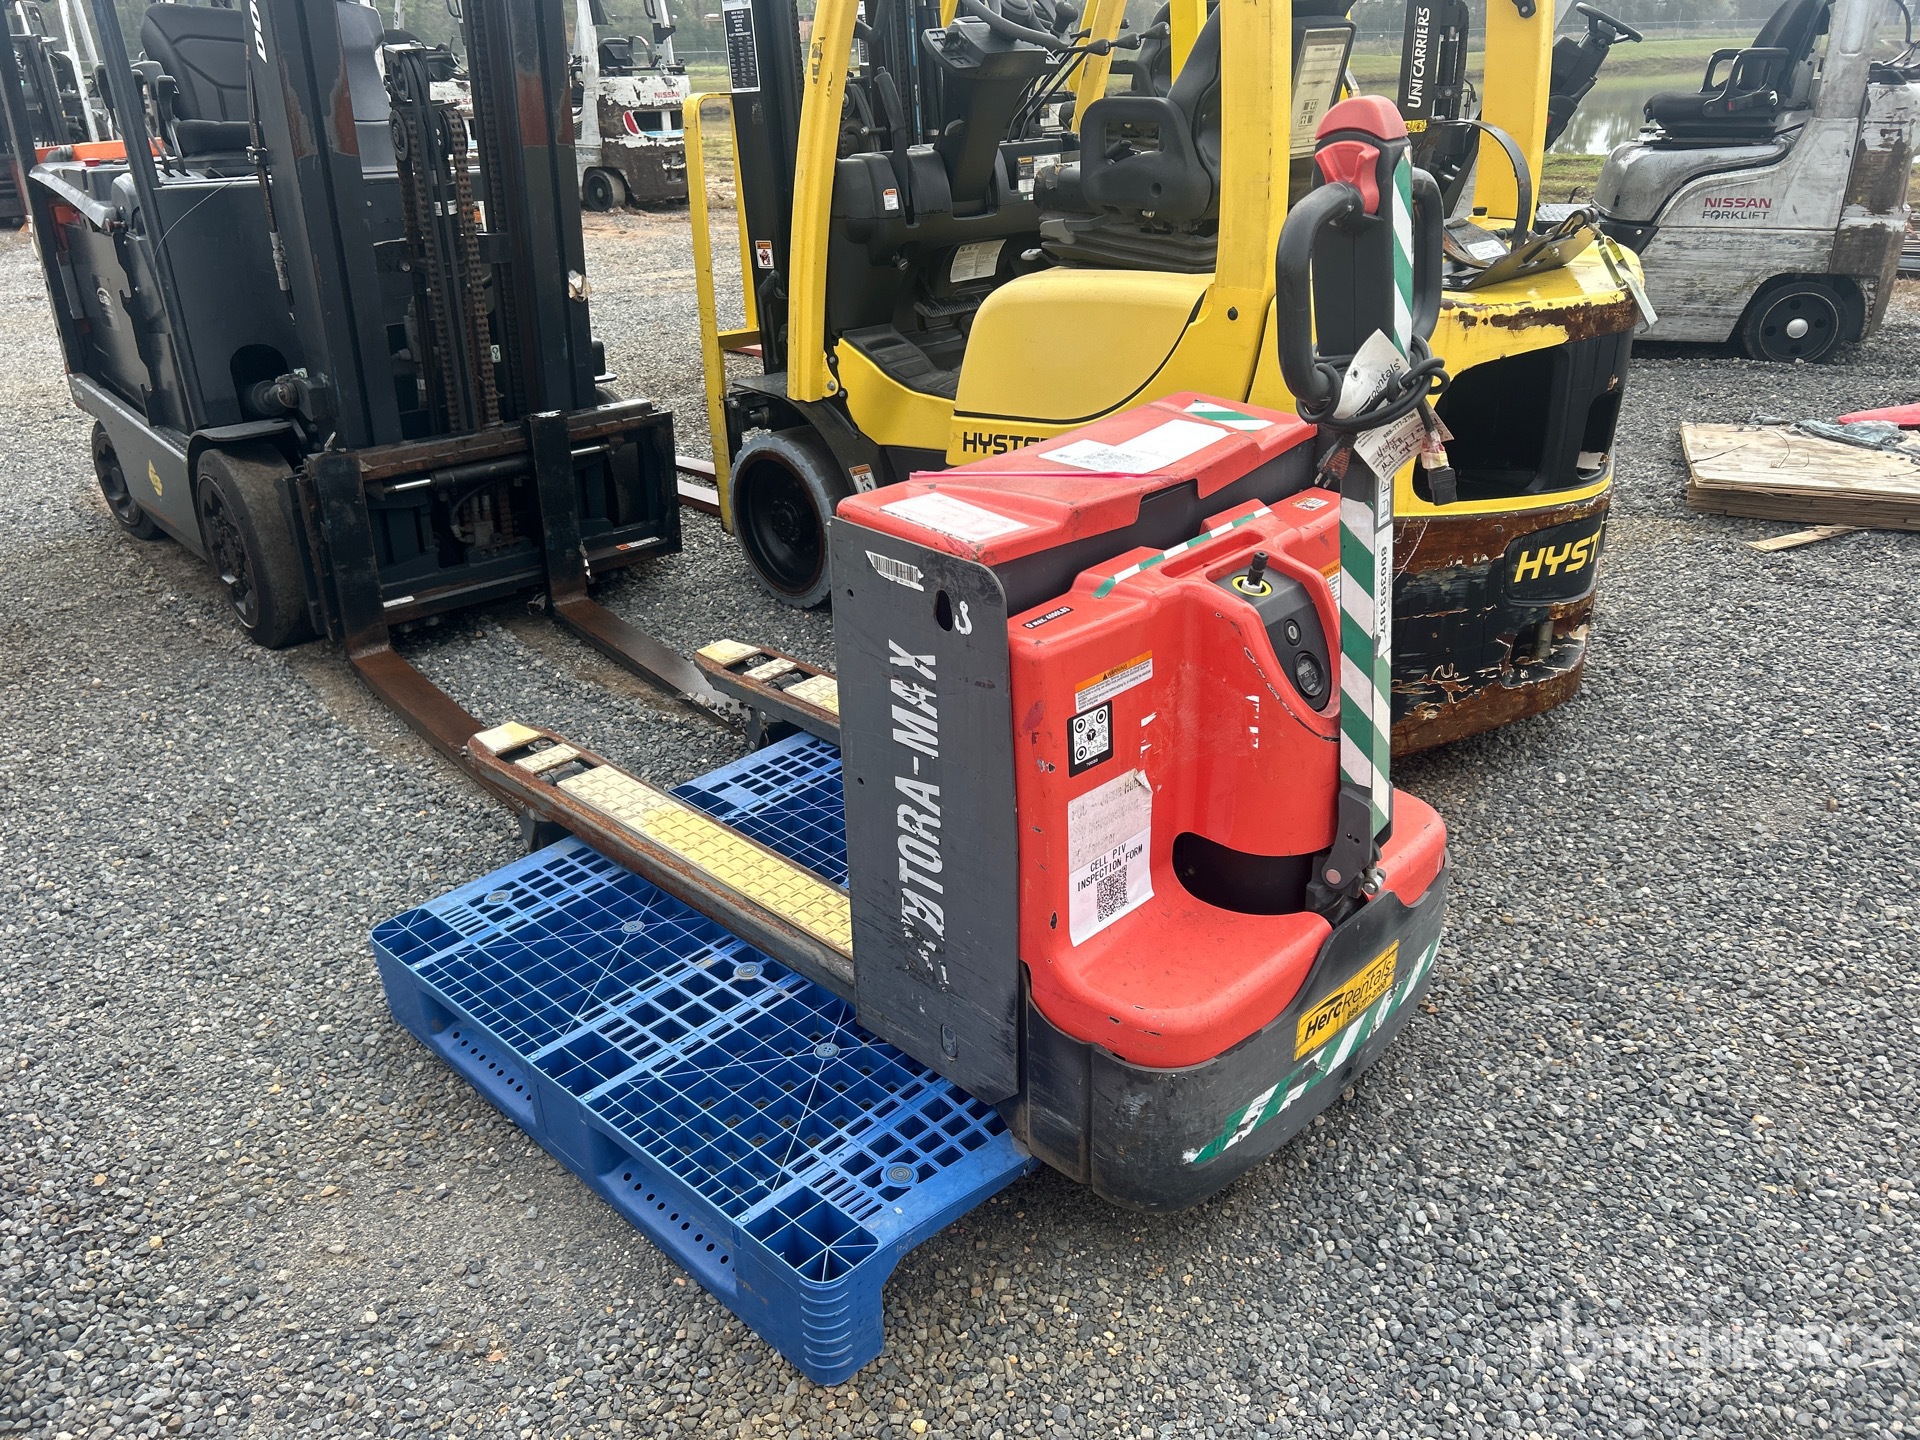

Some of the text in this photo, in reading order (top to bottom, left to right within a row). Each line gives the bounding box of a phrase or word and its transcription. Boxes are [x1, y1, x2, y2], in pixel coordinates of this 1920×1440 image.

[1407, 6, 1430, 109] UNICARRIERS
[654, 91, 680, 99] NISSAN
[1701, 210, 1770, 220] FORKLIFT
[1704, 197, 1773, 209] NISSAN
[962, 431, 1050, 455] HYST
[1513, 529, 1601, 583] HYST
[888, 638, 944, 895] TORA-MAX
[1077, 844, 1143, 892] INSPECTION FORM
[1090, 843, 1127, 873] CELL PIV
